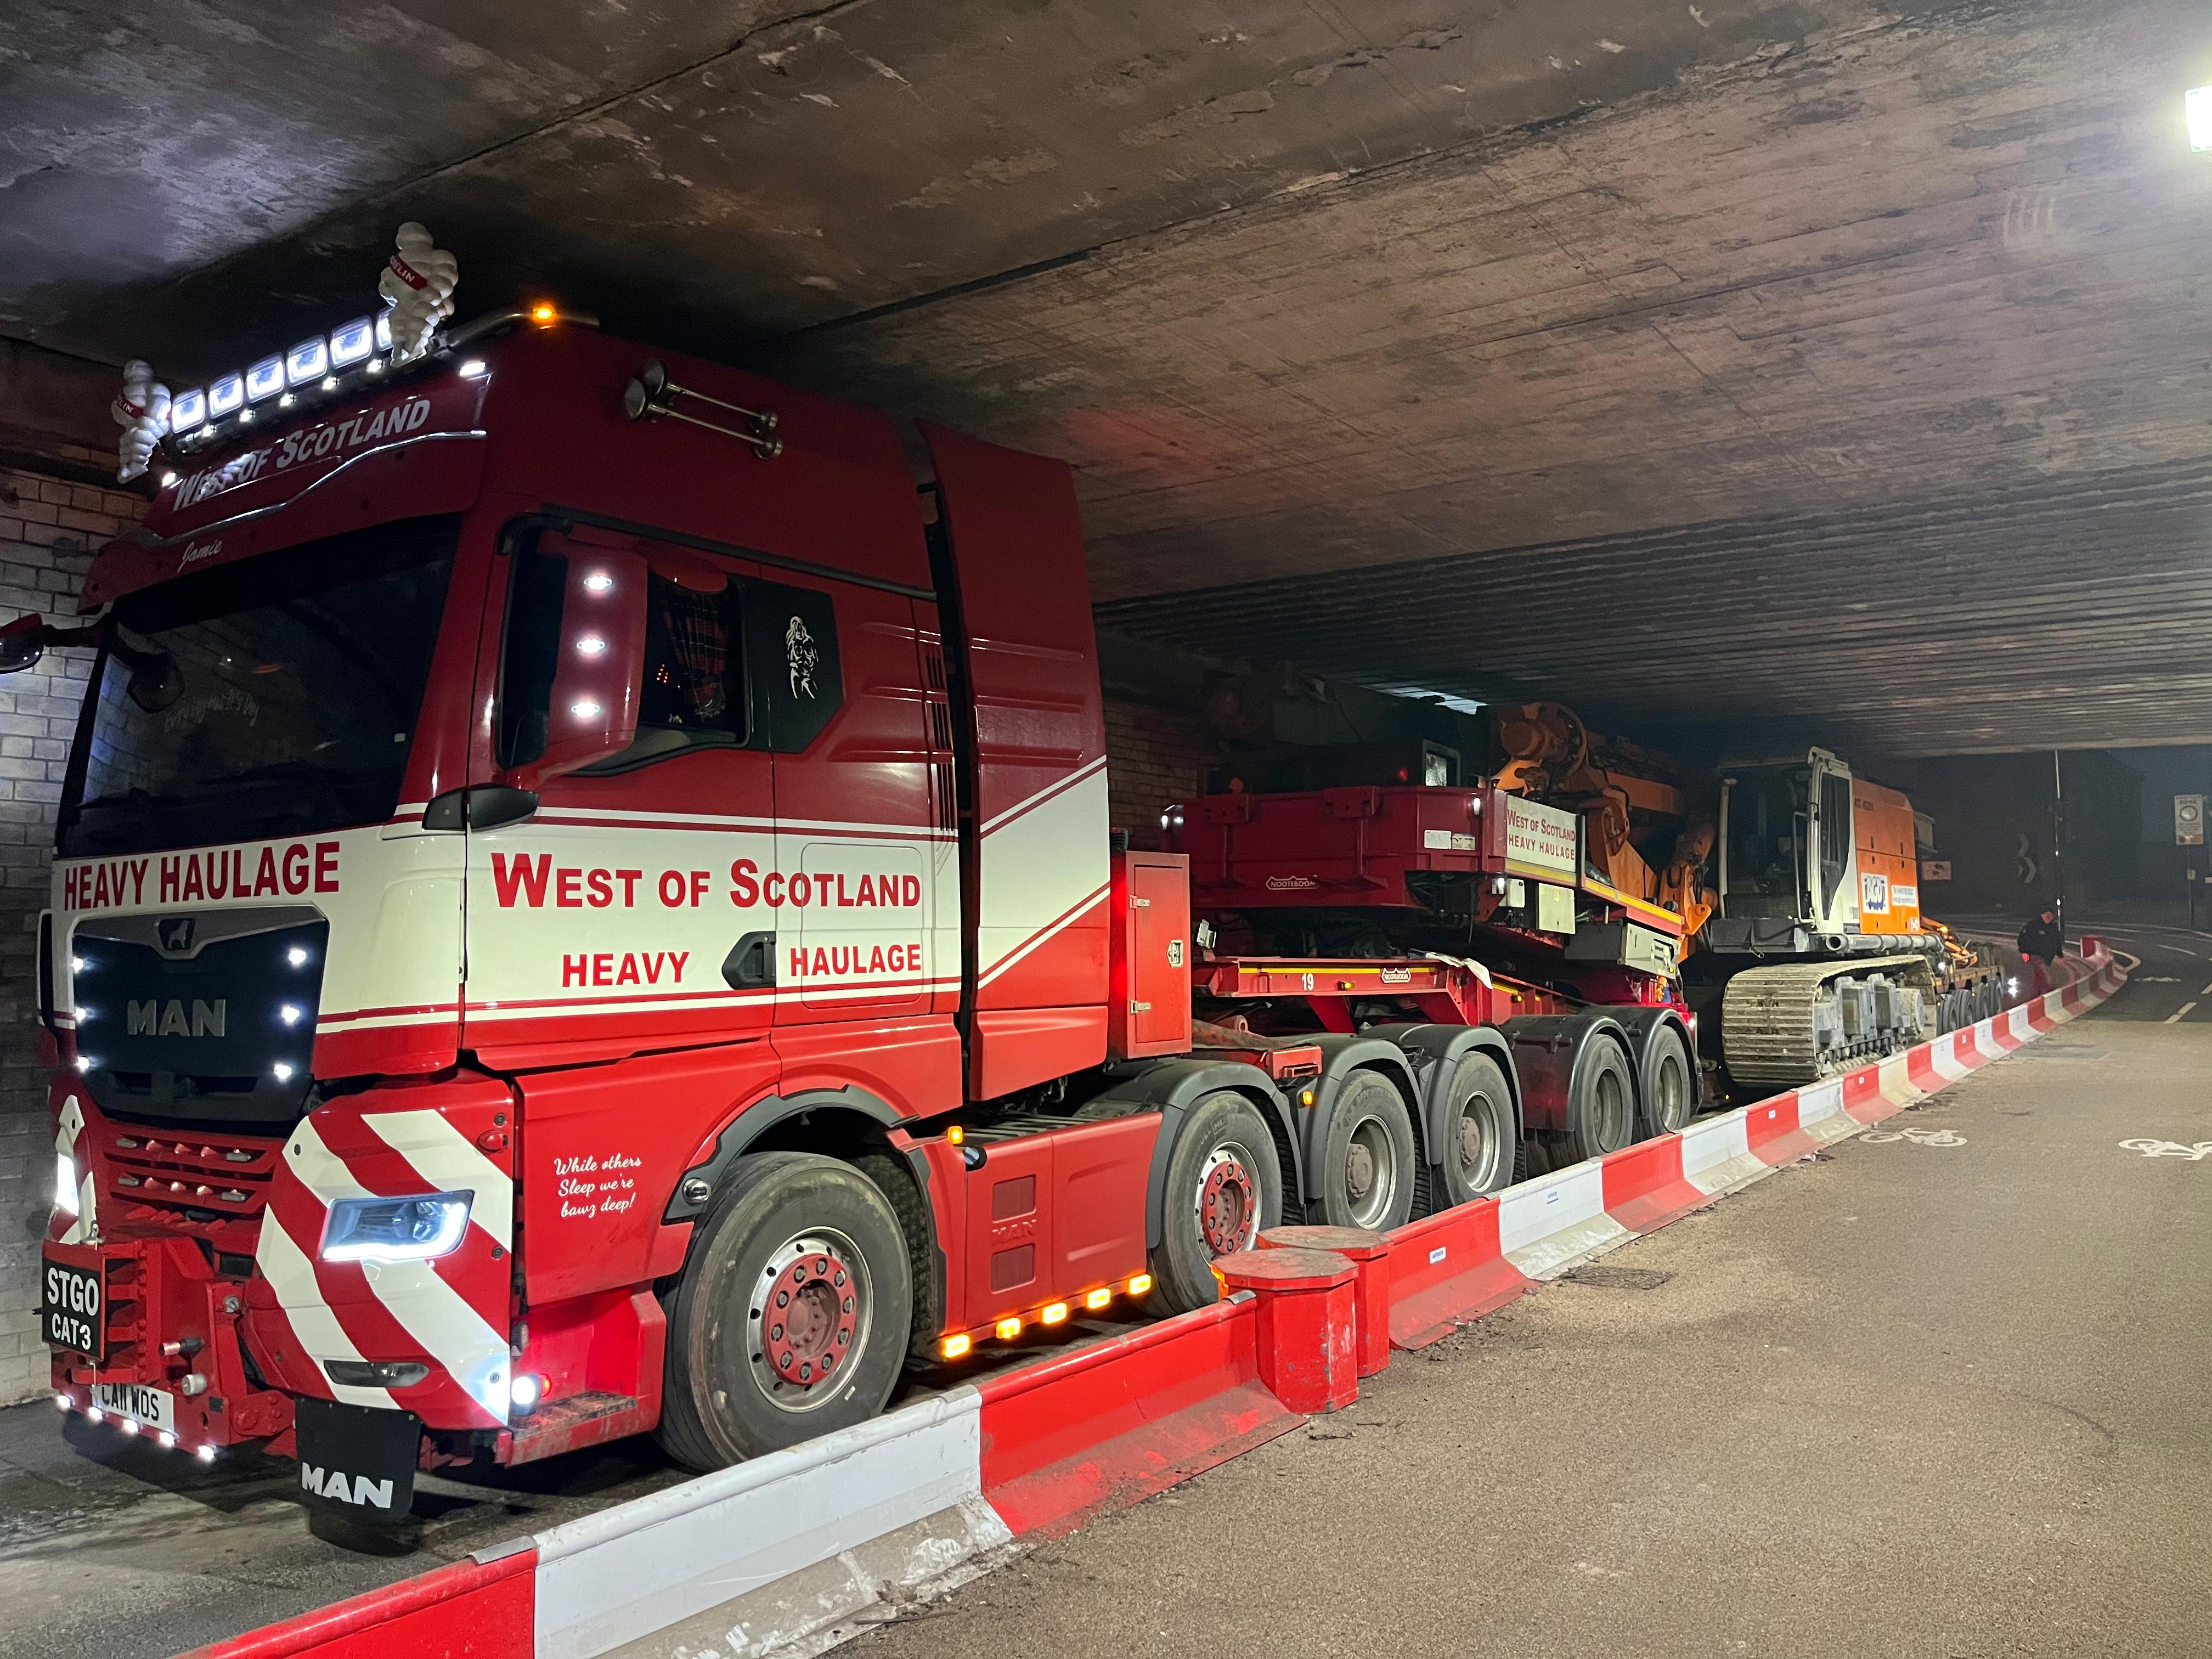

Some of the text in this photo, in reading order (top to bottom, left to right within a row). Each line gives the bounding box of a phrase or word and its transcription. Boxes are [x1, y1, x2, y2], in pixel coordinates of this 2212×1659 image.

[240, 447, 273, 484] OF
[276, 399, 431, 469] SCOTLAND
[177, 539, 223, 573] Jamie
[1507, 809, 1576, 841] WEST OF SCOTLAND
[1509, 834, 1575, 860] HEAVY HAULAGE
[64, 841, 340, 911] HEAVY HAULAGE
[491, 852, 921, 908] WEST OF SCOTLAND
[562, 944, 922, 987] HEAVY HAULAGE
[1301, 973, 1314, 991] 19
[127, 999, 225, 1037] MAN
[554, 1153, 642, 1175] While others
[558, 1173, 634, 1197] Sleep we're
[600, 1192, 636, 1214] deep!
[47, 1267, 99, 1316] STGO
[52, 1313, 91, 1350] CAT 3
[131, 1386, 159, 1421] WOS
[302, 1462, 393, 1509] MAN
